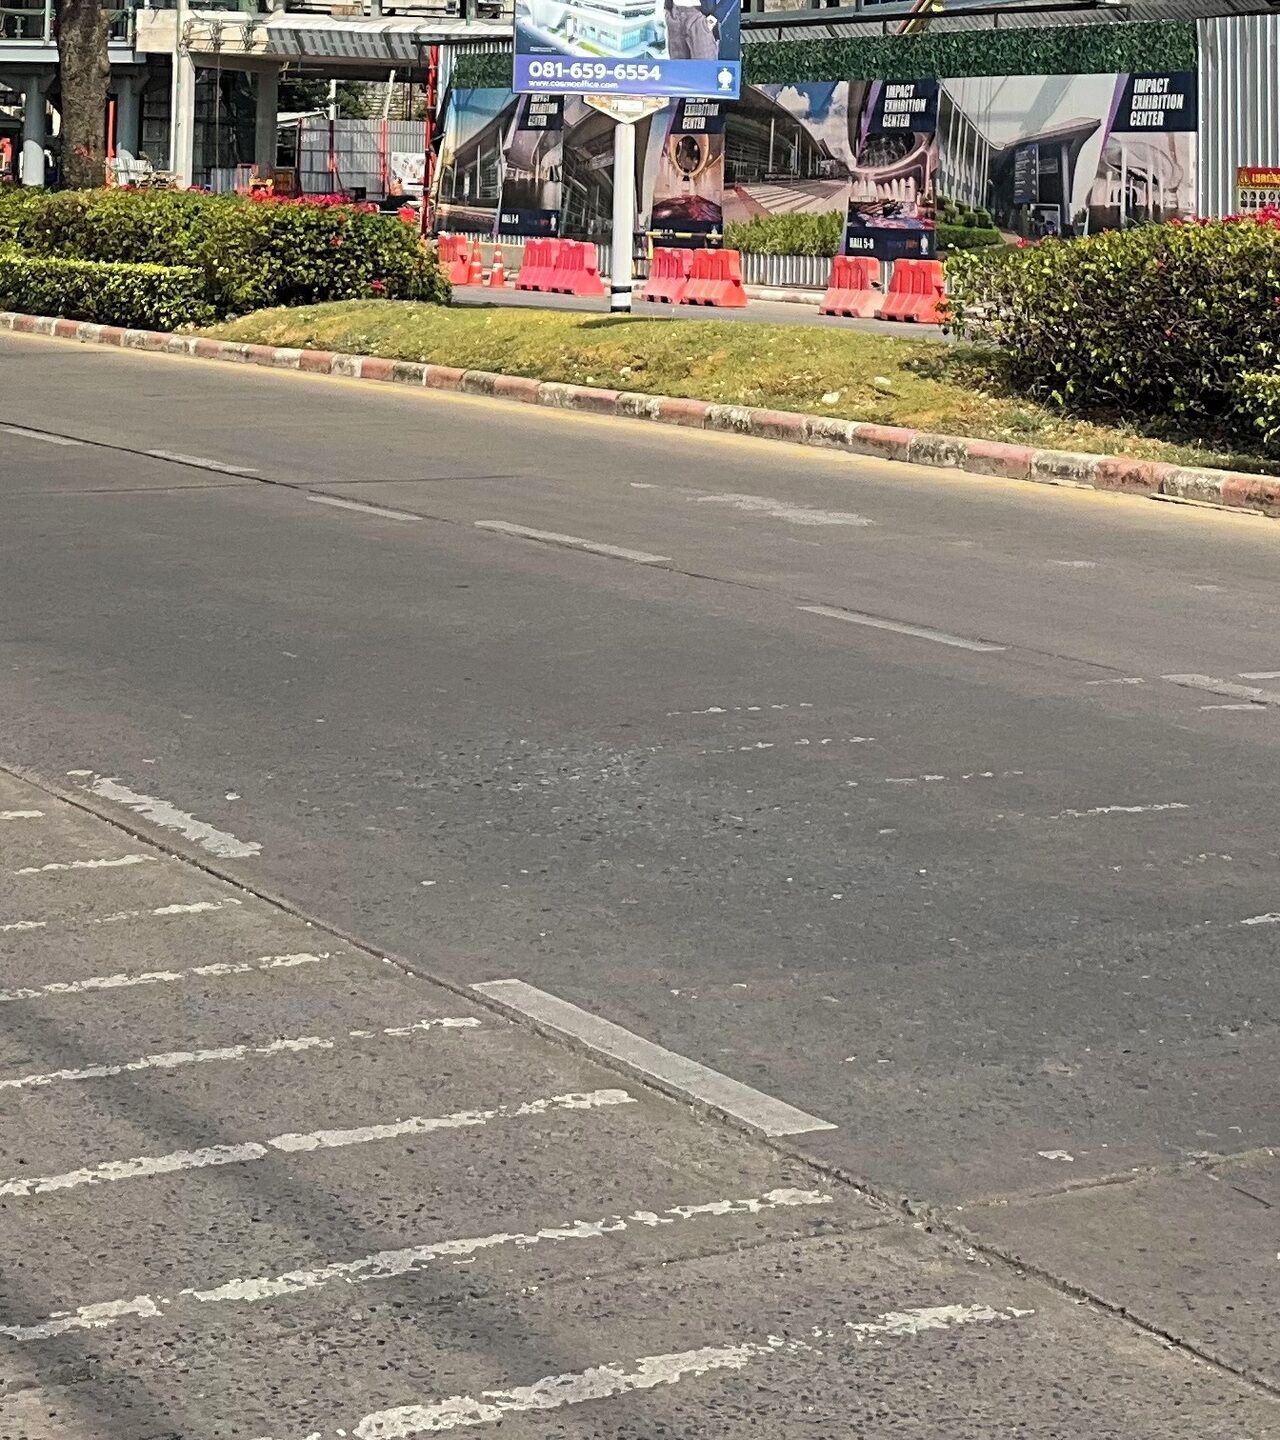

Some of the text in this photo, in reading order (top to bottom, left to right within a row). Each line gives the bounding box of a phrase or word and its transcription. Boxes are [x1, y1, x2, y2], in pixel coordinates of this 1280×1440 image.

[528, 61, 662, 81] 081-659-6554
[886, 84, 915, 99] IMPACT
[1134, 78, 1170, 94] IMPACT
[884, 99, 927, 113] EXHIBITION
[1131, 94, 1184, 110] EXHIBITION
[882, 114, 911, 128] CENTER
[1129, 111, 1164, 127] CENTER
[849, 237, 863, 249] HALL
